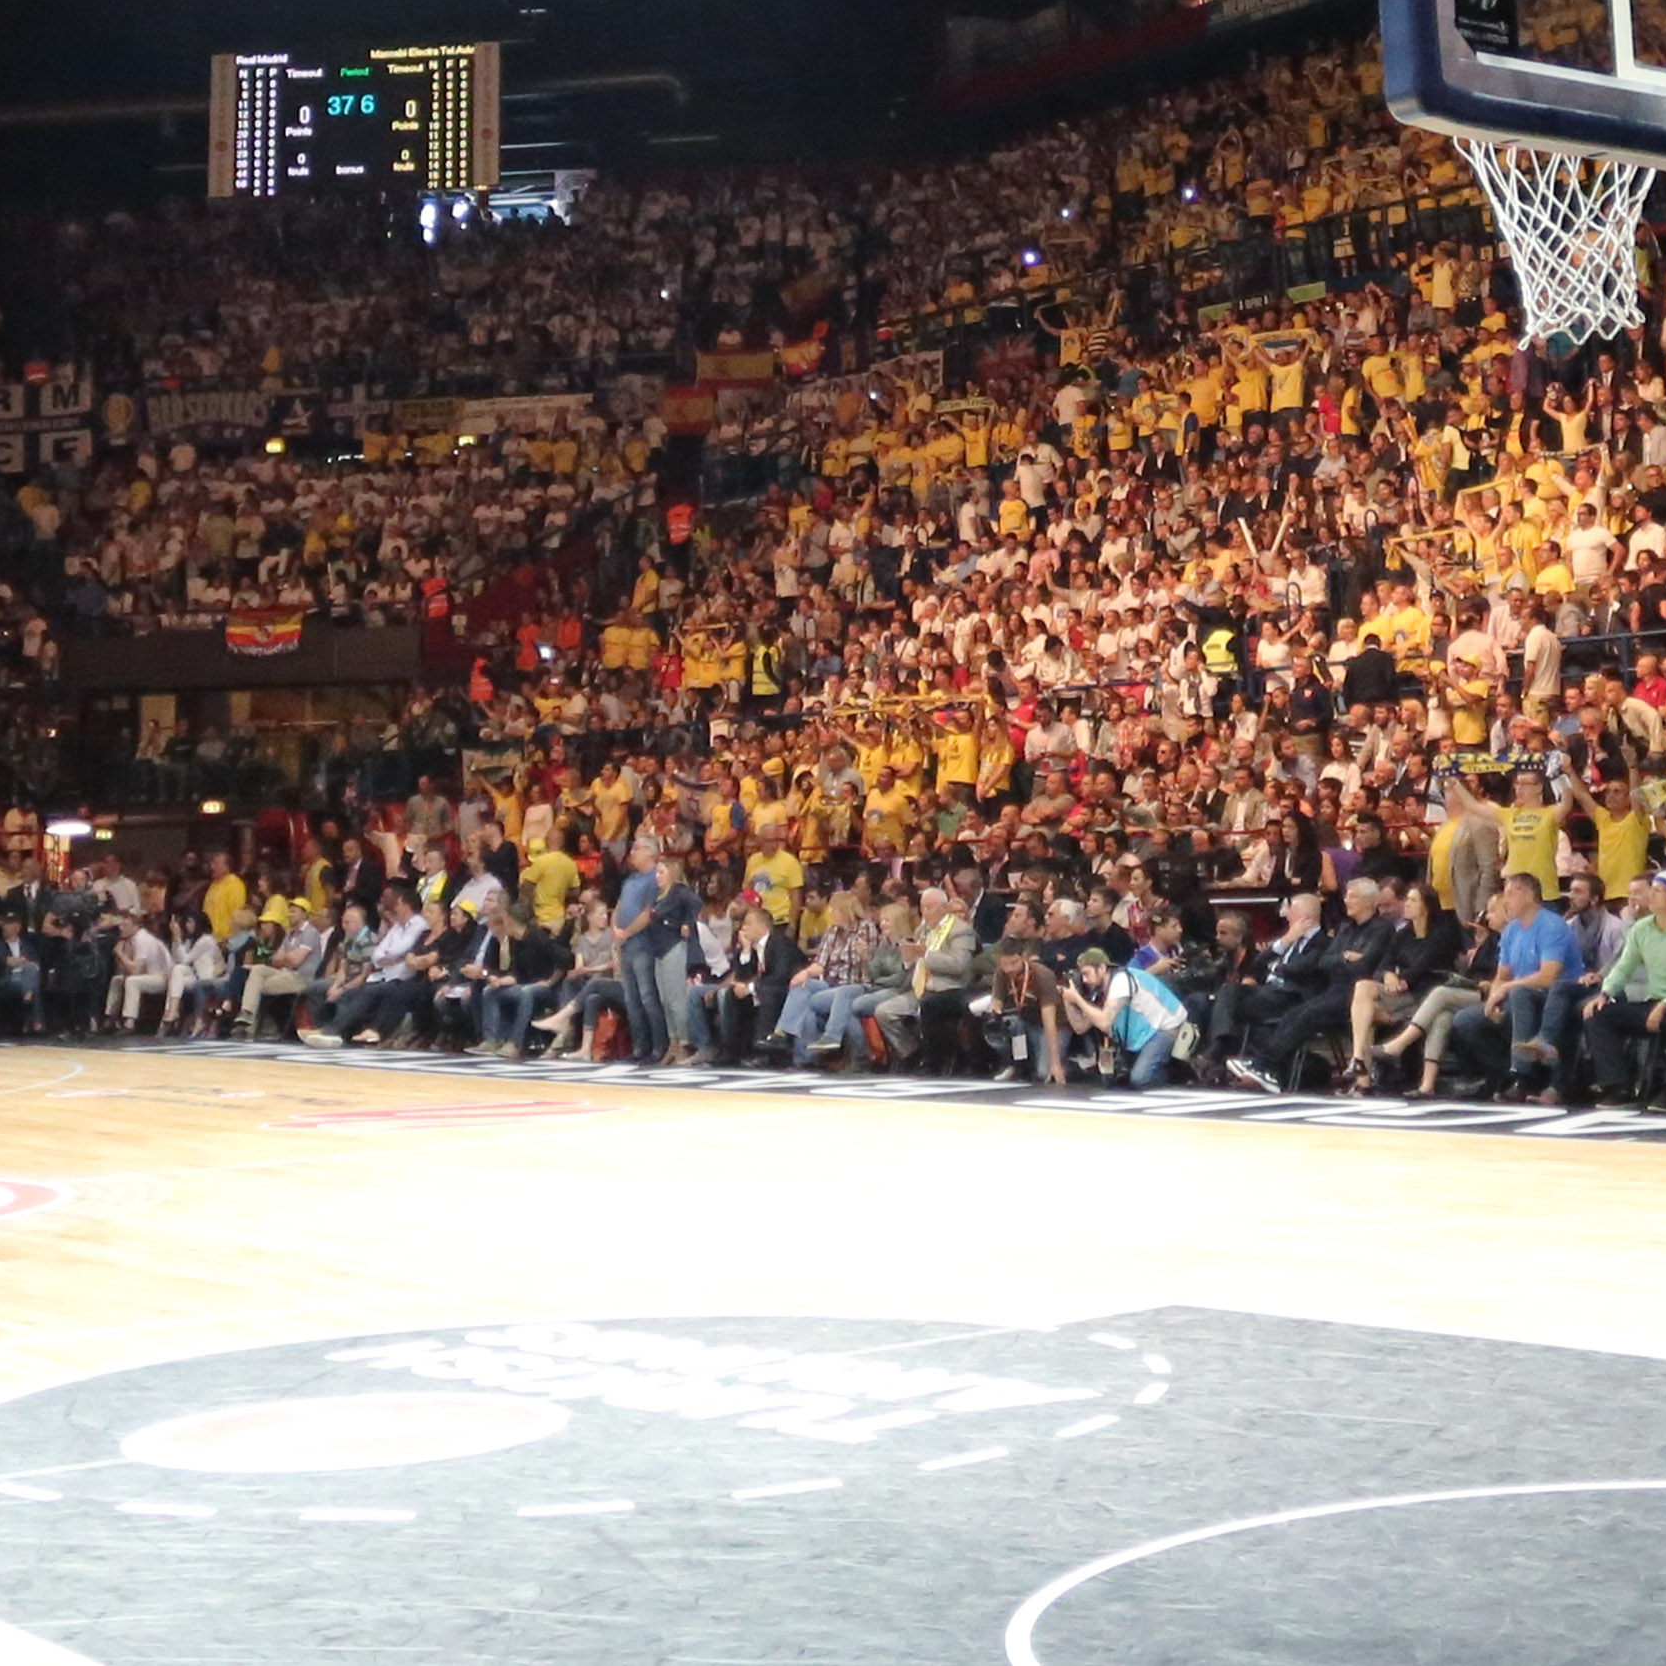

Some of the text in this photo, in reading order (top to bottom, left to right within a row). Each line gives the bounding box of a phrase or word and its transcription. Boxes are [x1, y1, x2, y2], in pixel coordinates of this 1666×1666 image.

[236, 54, 288, 65] Real Madrid
[286, 68, 323, 78] Timeout
[387, 64, 424, 74] Timeout
[327, 94, 375, 115] 37 6
[405, 99, 417, 118] 0
[299, 105, 311, 124] 0
[297, 153, 306, 164] 0
[401, 149, 410, 160] 0
[52, 384, 81, 410] M
